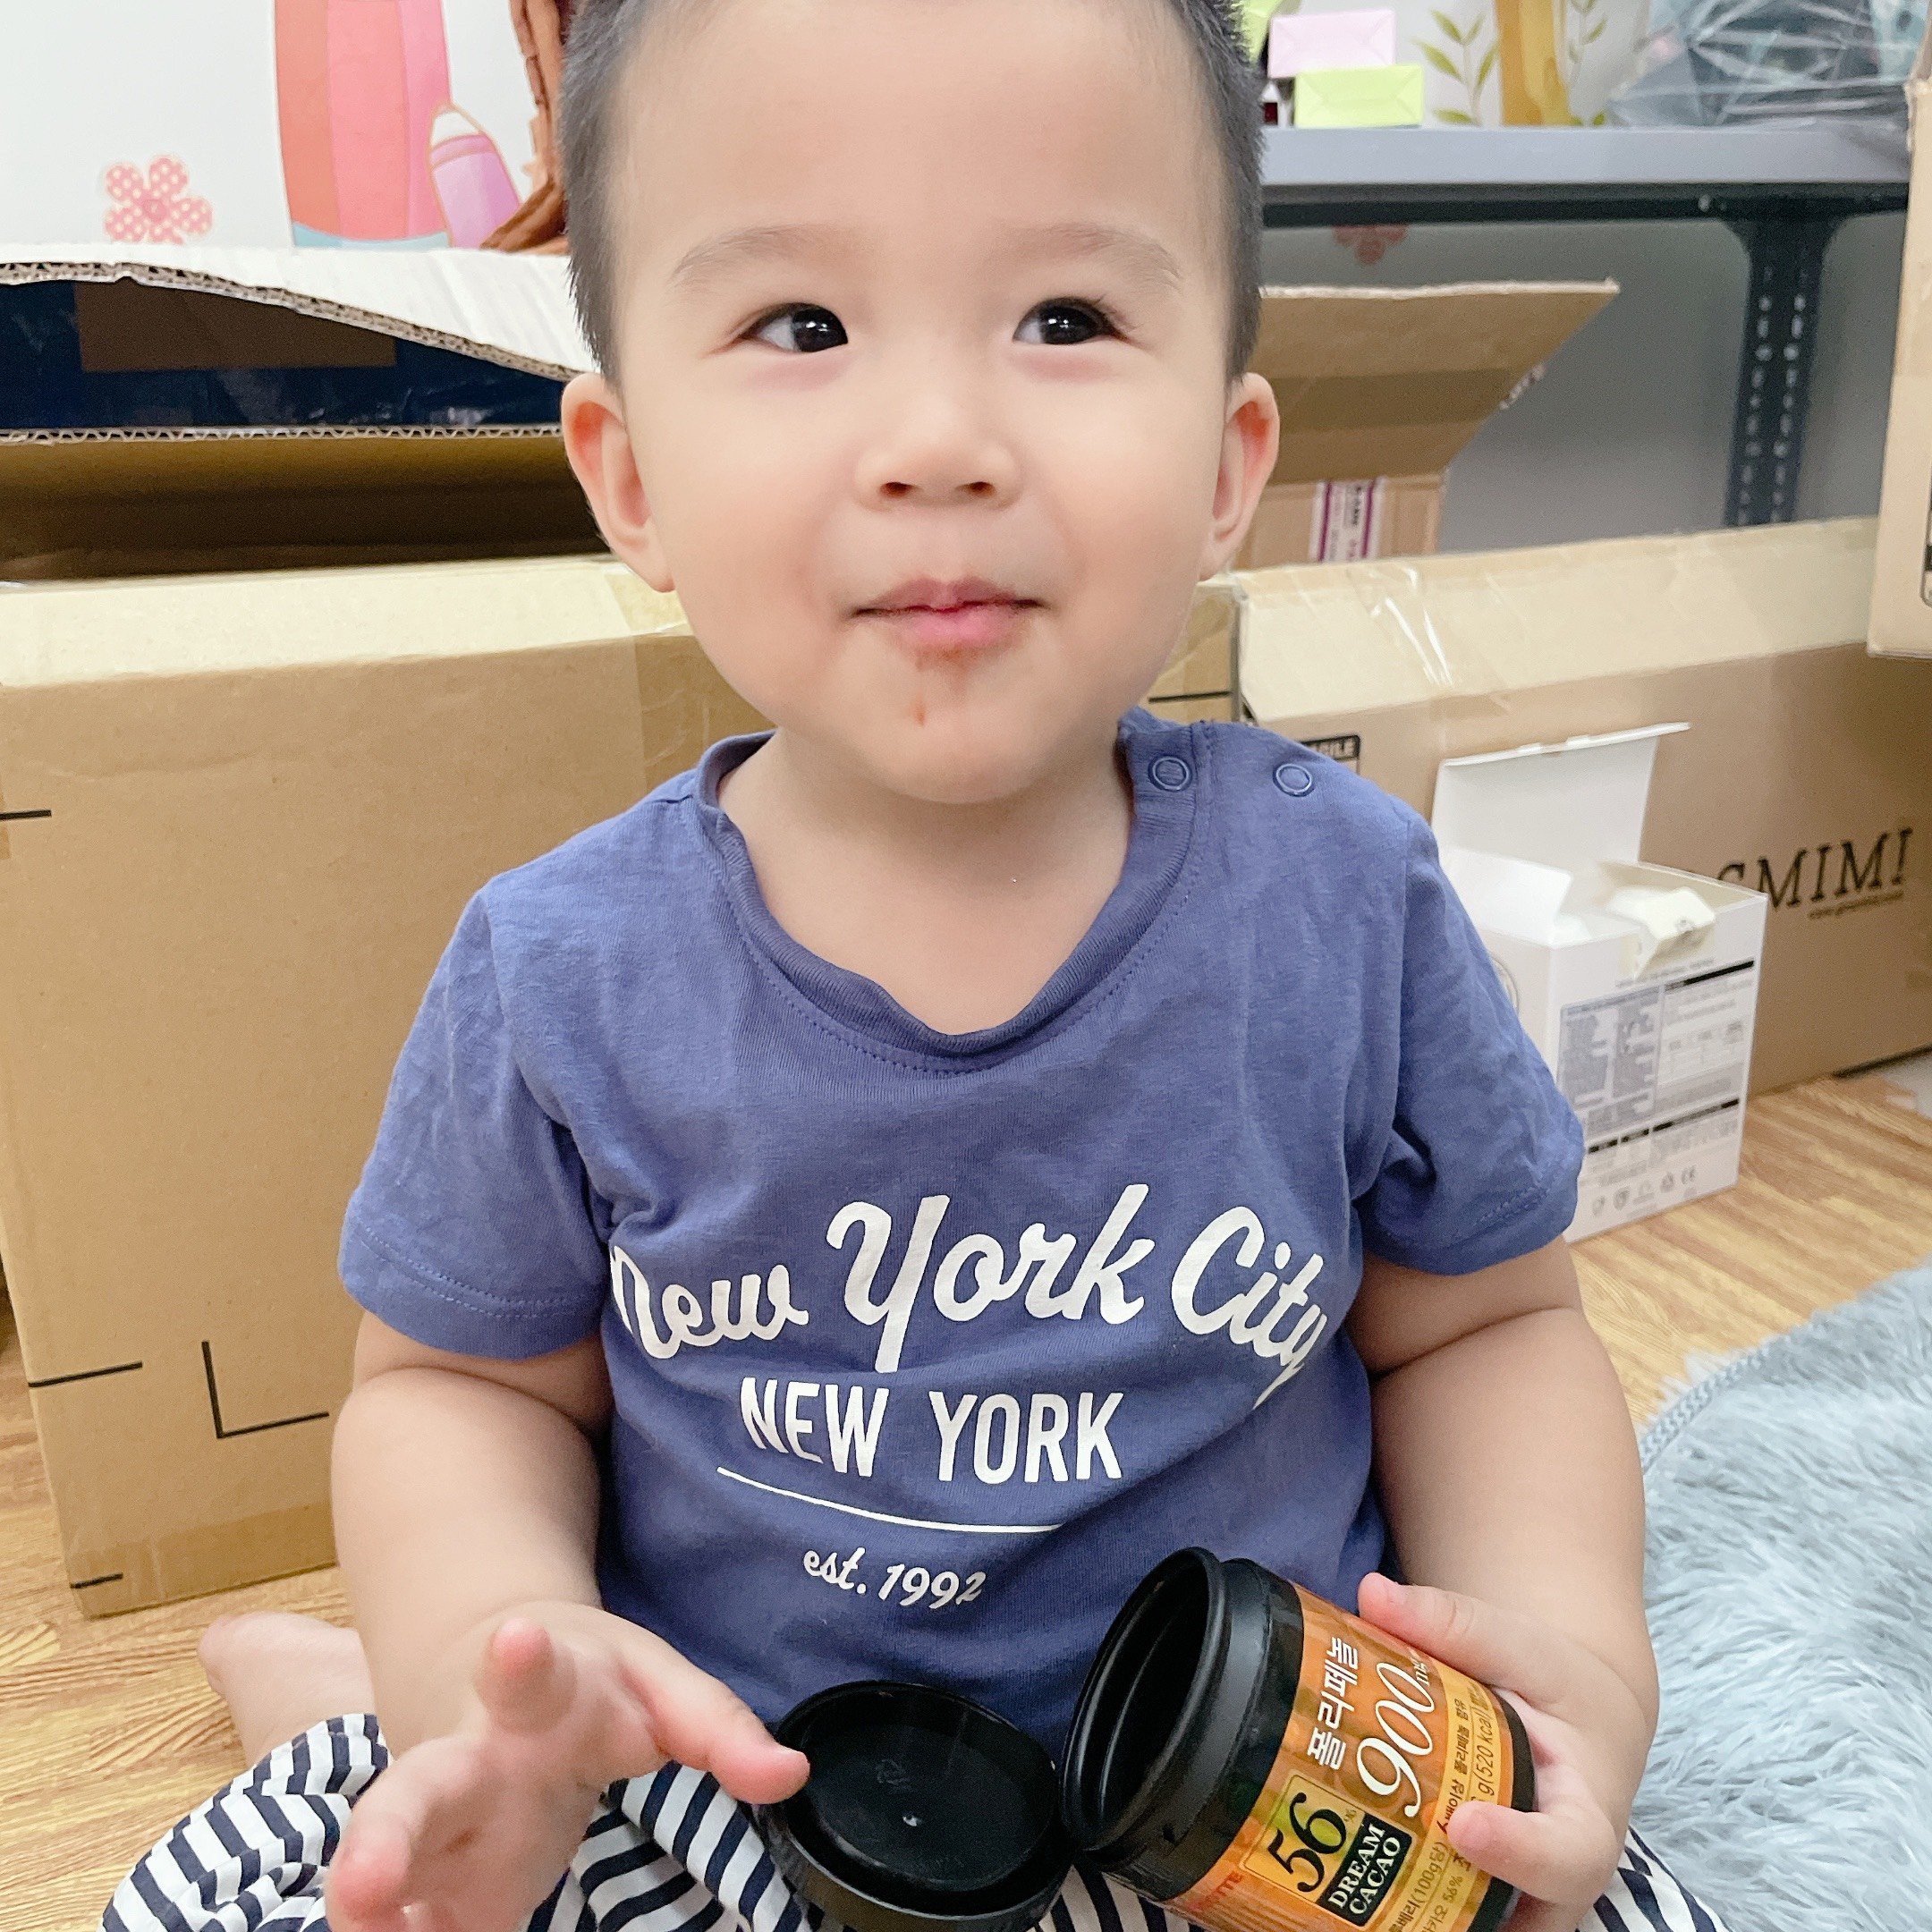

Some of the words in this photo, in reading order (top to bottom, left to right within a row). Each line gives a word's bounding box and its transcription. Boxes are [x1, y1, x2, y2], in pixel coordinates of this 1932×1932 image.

[609, 1246, 809, 1360] New
[826, 1183, 1156, 1373] York
[1172, 1206, 1327, 1411] City
[739, 1377, 889, 1478] NEW
[928, 1392, 1124, 1485] YORK
[803, 1548, 867, 1595] est.
[877, 1563, 987, 1610] 1992
[1307, 1636, 1359, 1771] 폴리페놀
[1327, 1822, 1385, 1910] DREAM
[1348, 1836, 1402, 1916] CACAO
